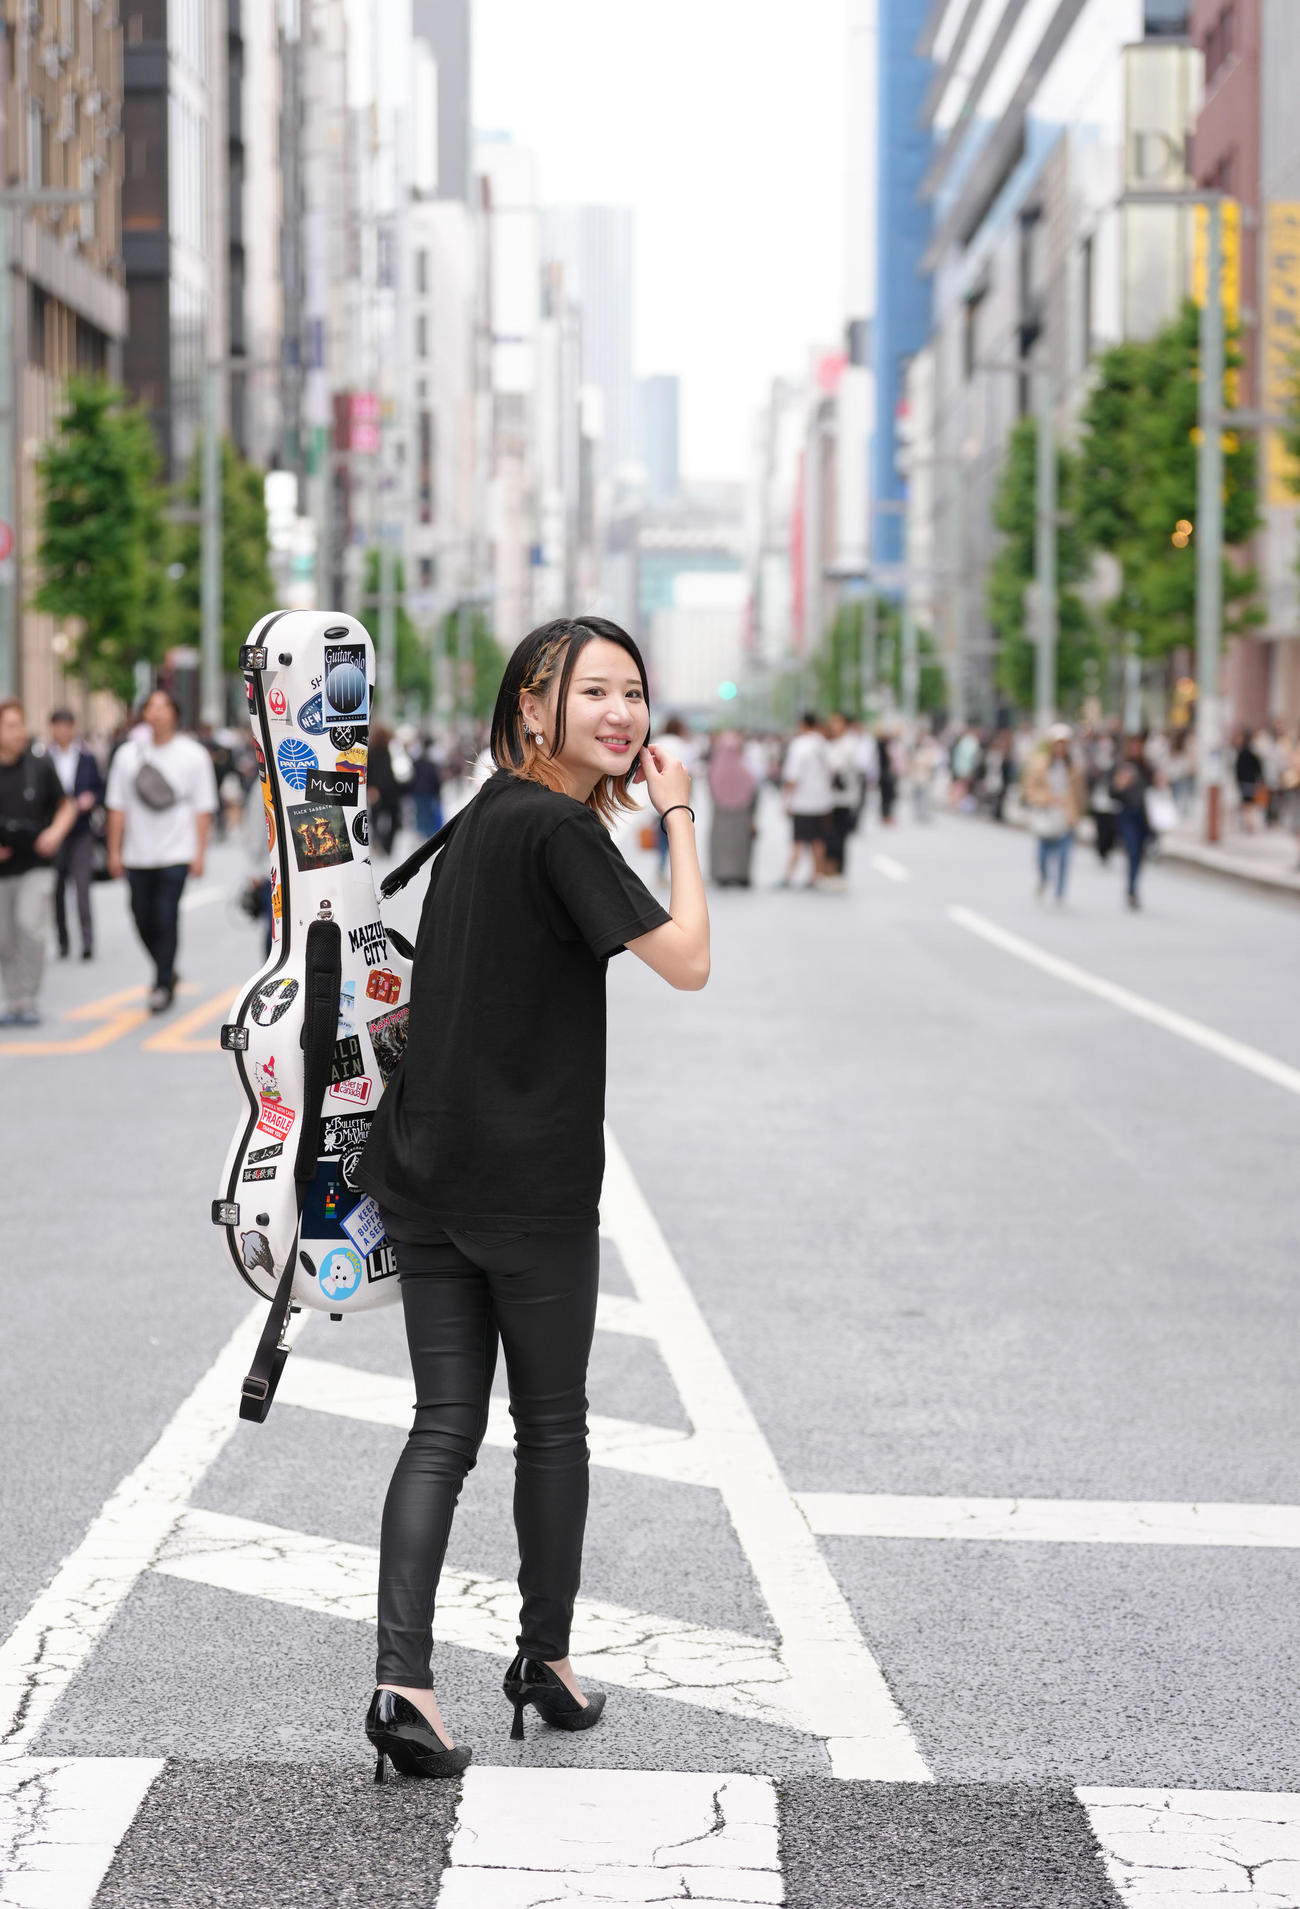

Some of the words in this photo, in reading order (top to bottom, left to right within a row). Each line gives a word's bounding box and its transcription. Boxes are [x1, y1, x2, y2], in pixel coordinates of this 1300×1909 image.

[325, 646, 351, 665] Guitar
[350, 652, 366, 671] Solo
[301, 711, 322, 729] NEW
[279, 760, 296, 768] PAN
[297, 759, 315, 768] AM
[363, 939, 388, 966] CITY
[368, 1016, 391, 1033] IRON
[262, 1109, 292, 1132] FRAGILE
[357, 1200, 375, 1222] KEEP
[363, 1237, 371, 1246] A
[346, 1250, 361, 1274] PEACE
